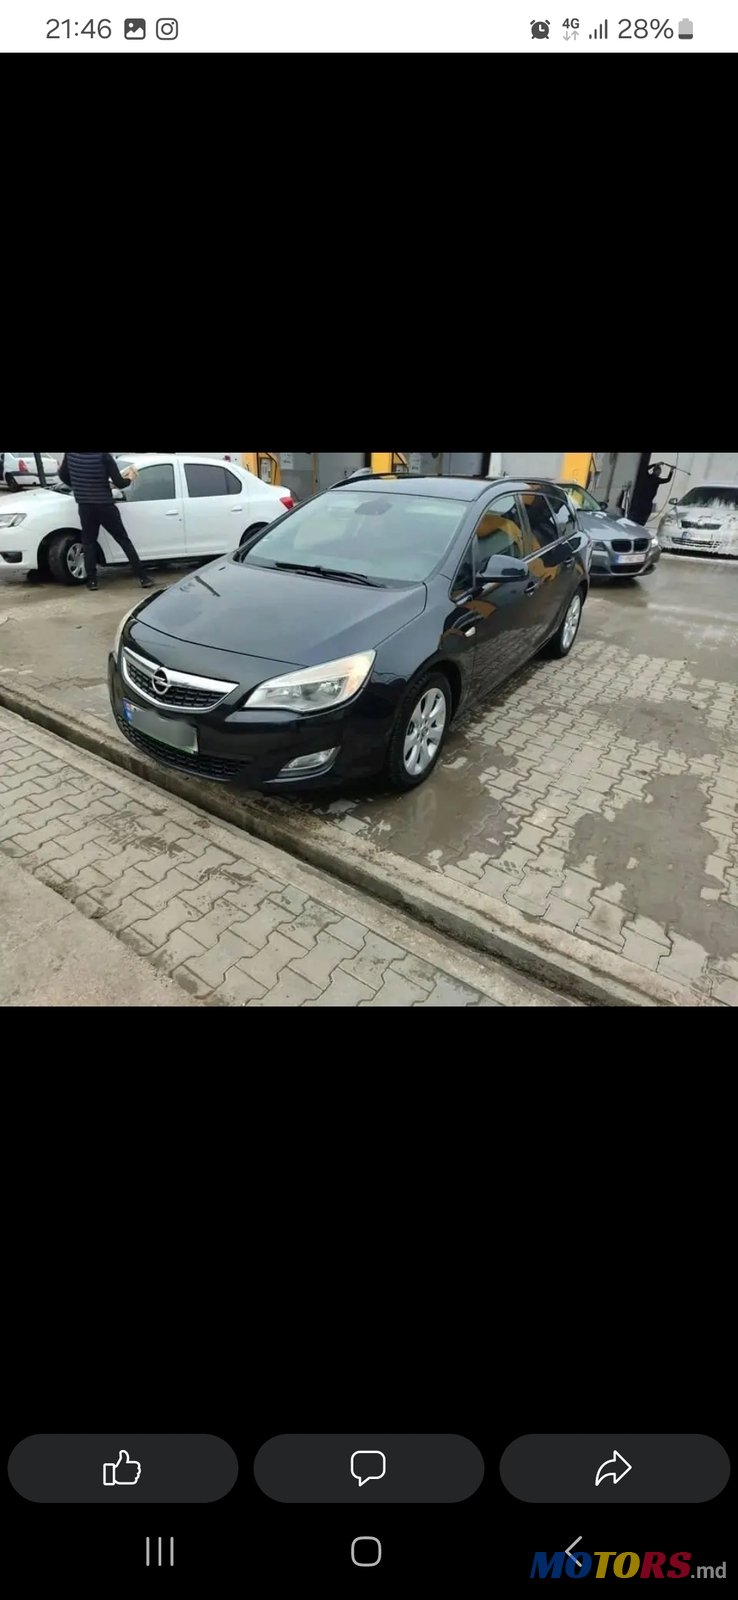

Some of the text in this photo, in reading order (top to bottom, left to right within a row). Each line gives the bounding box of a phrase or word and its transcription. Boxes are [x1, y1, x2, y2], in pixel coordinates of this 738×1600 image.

[46, 18, 112, 39] 21:46
[561, 17, 580, 29] 4G
[618, 18, 674, 39] 28%
